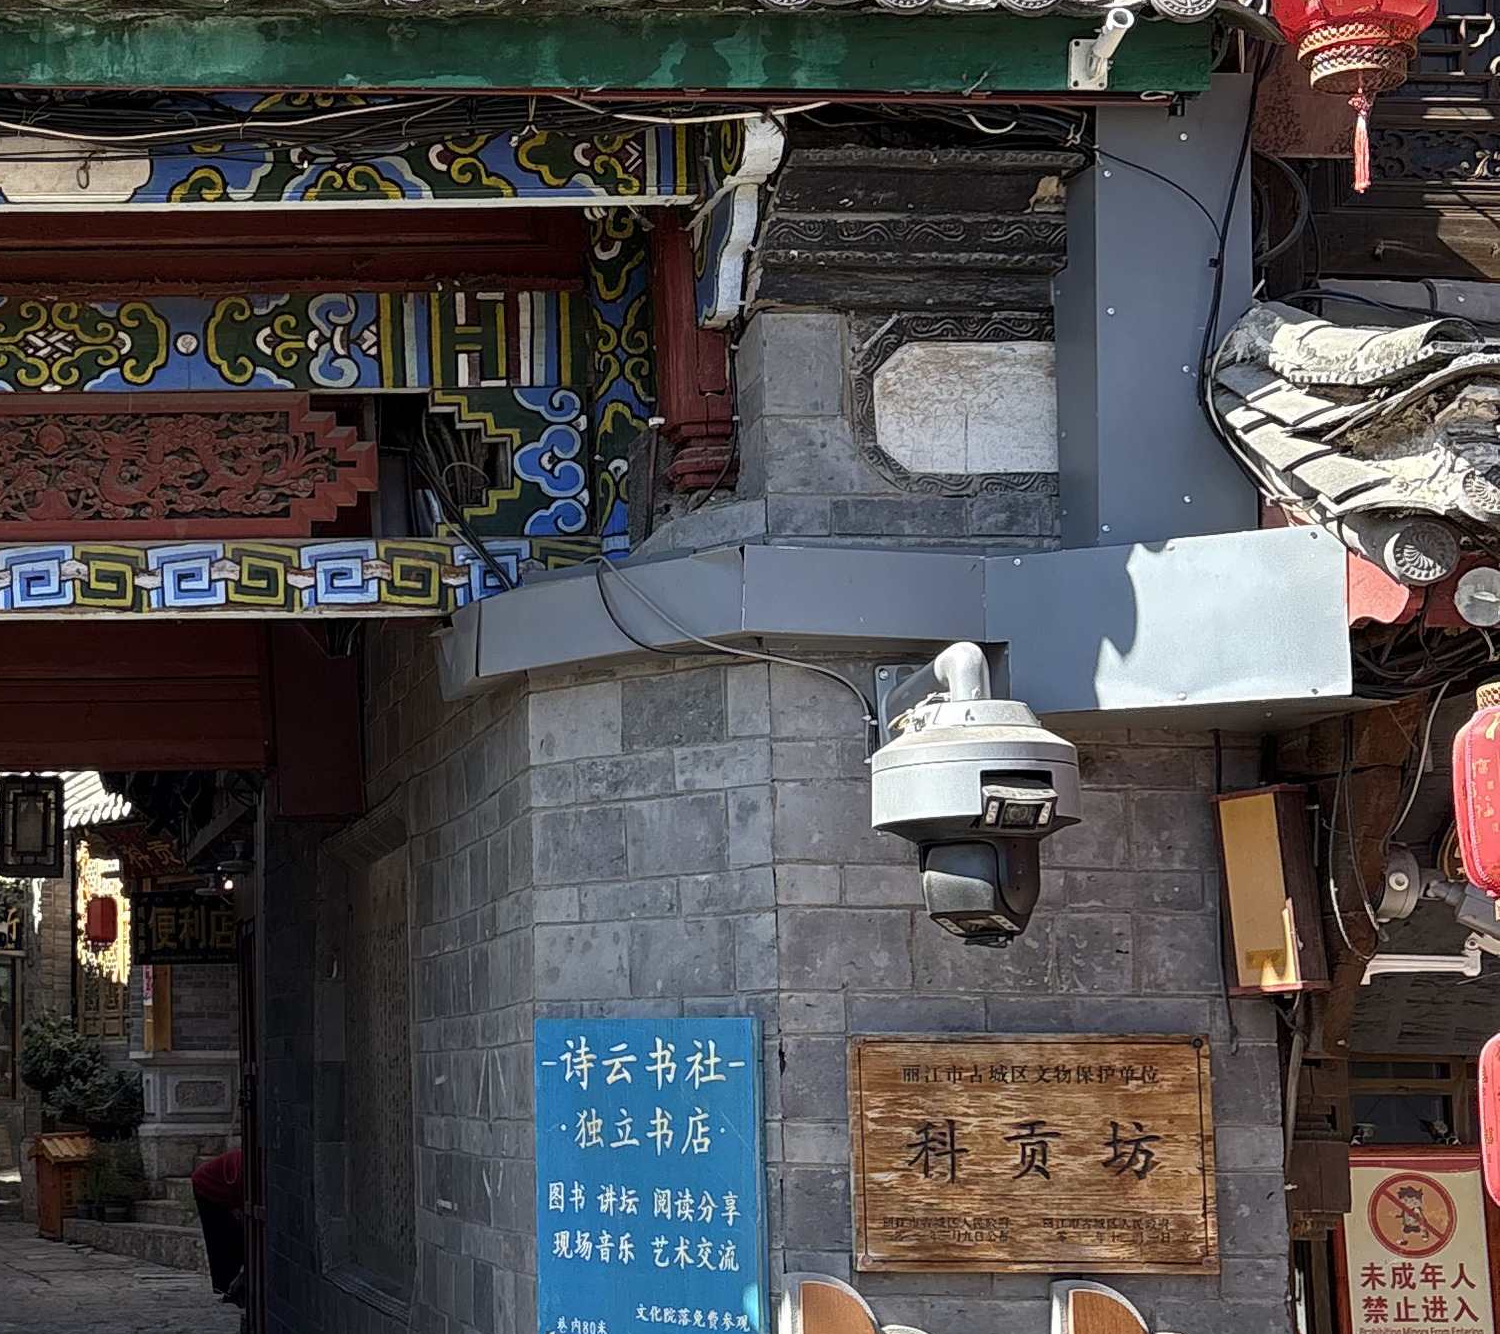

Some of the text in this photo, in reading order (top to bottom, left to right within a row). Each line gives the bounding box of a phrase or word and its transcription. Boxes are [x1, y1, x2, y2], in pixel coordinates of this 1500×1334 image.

[148, 903, 237, 951] 便利店
[902, 1064, 1160, 1085] 丽江市古城区文物保护单位
[906, 1119, 1161, 1184] 科贡坊
[548, 1180, 740, 1228] 图书 讲坛 阅读分享
[552, 1230, 739, 1272] 现场音乐 艺术交流
[1361, 1262, 1476, 1291] 未成年人
[635, 1303, 751, 1333] 文化院落免费参观
[1362, 1295, 1479, 1325] 禁止进入
